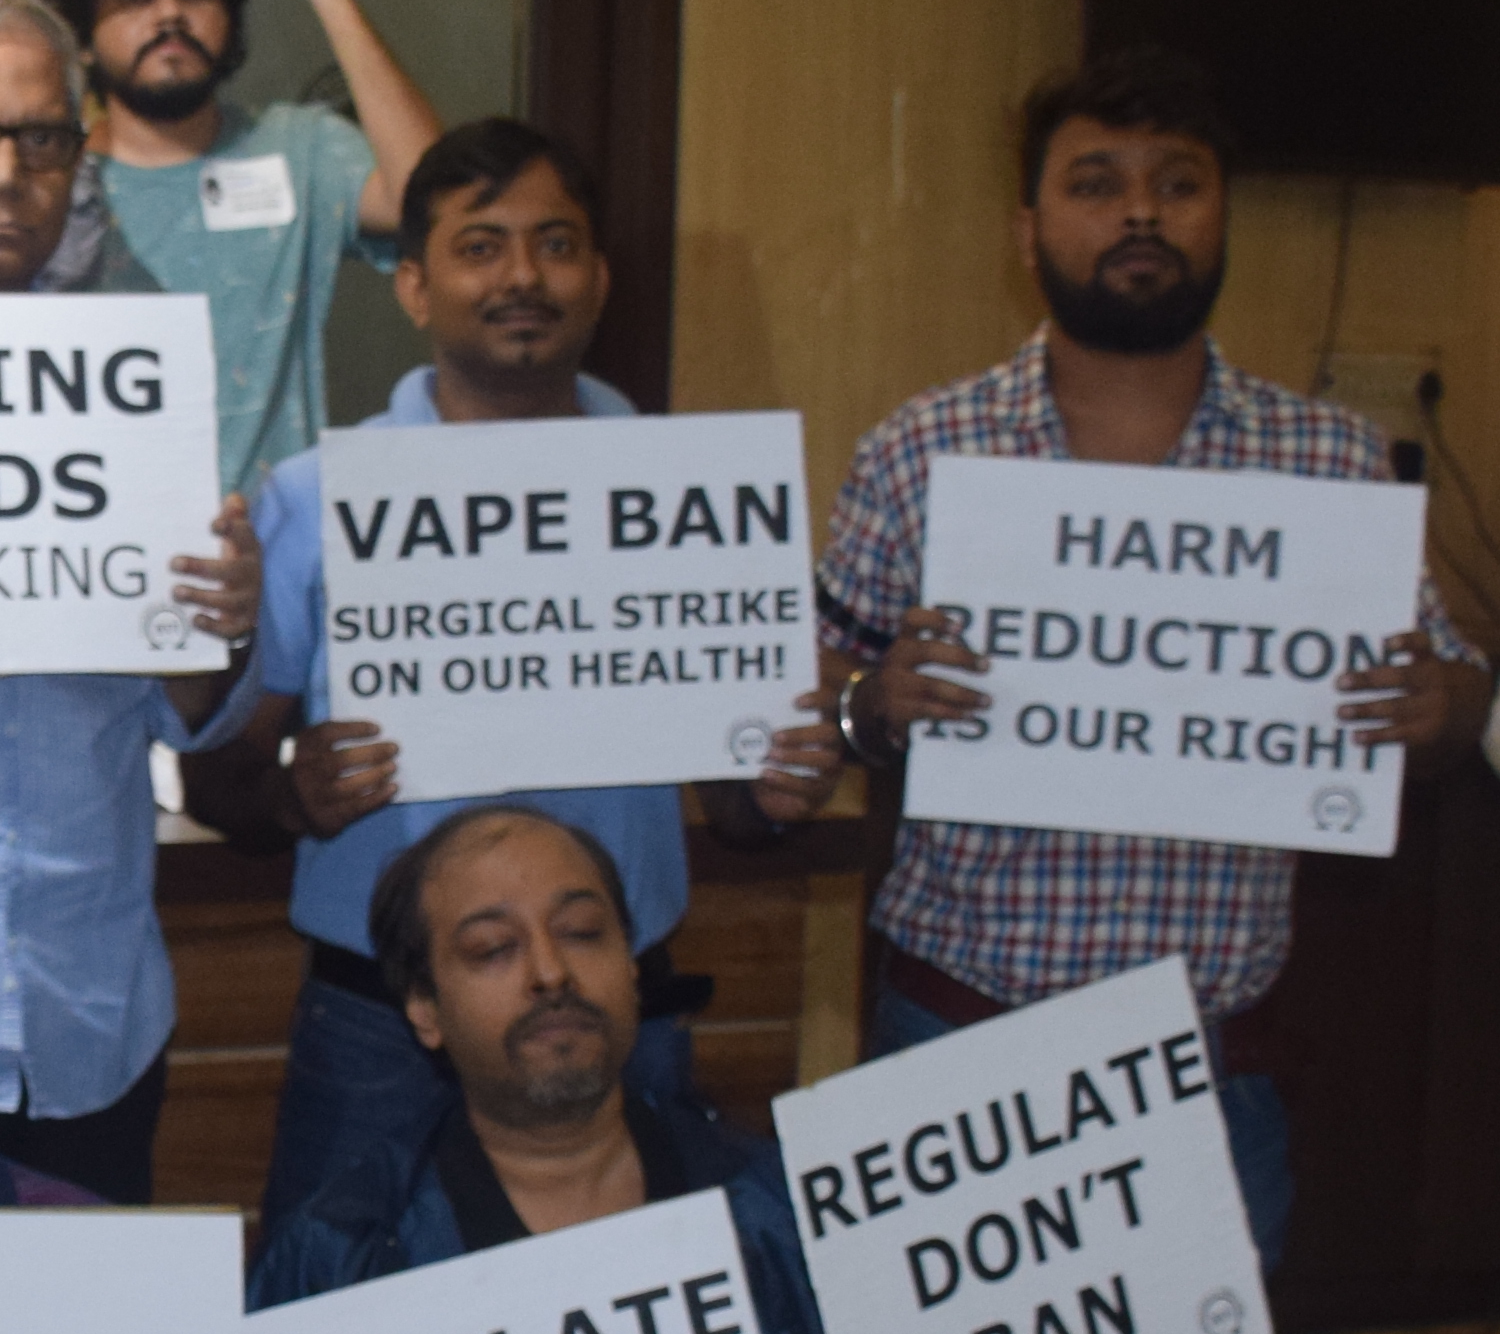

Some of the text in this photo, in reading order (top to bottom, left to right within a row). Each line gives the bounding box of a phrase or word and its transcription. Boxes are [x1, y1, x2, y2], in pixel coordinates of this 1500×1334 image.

[334, 483, 792, 562] VAPE BAN
[1055, 514, 1282, 581] HARM
[333, 589, 801, 643] SURGICAL STRIKE
[349, 646, 786, 700] ON OUR HEALTH!
[1017, 704, 1152, 755] OUR
[802, 1030, 1208, 1240] REGULATE
[907, 1159, 1144, 1311] DON'T
